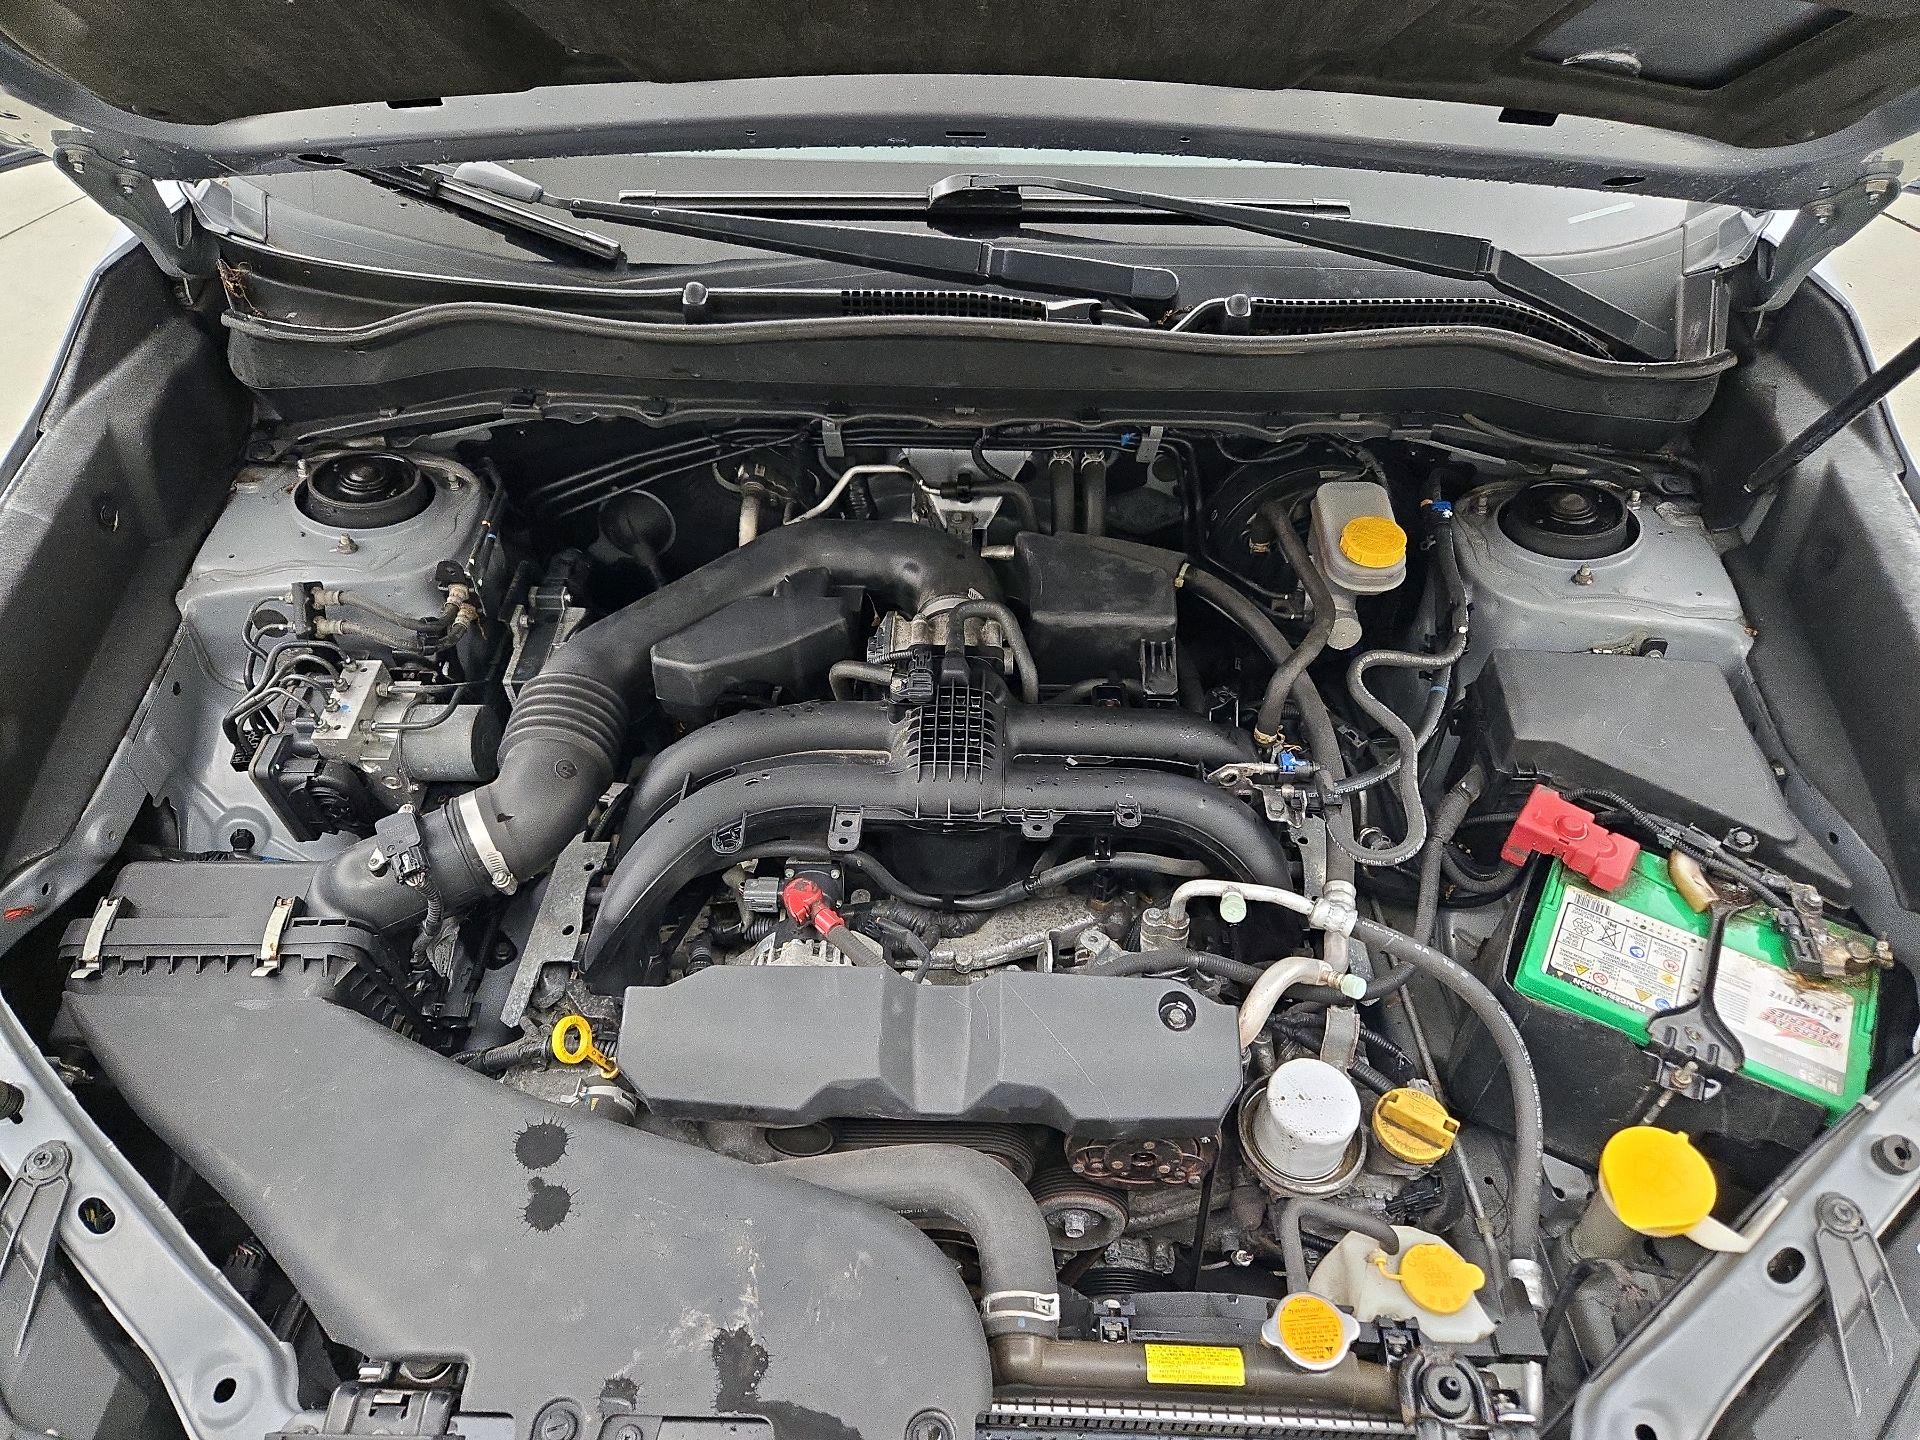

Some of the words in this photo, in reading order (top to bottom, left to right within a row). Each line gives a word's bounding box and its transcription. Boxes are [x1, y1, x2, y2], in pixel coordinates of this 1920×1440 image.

[1572, 977, 1646, 1012] DANGER/POISON
[1767, 989, 1841, 1023] AUTOMOTIVE
[1759, 1012, 1841, 1050] INTERSTATE
[1768, 1007, 1838, 1040] BATTERIES
